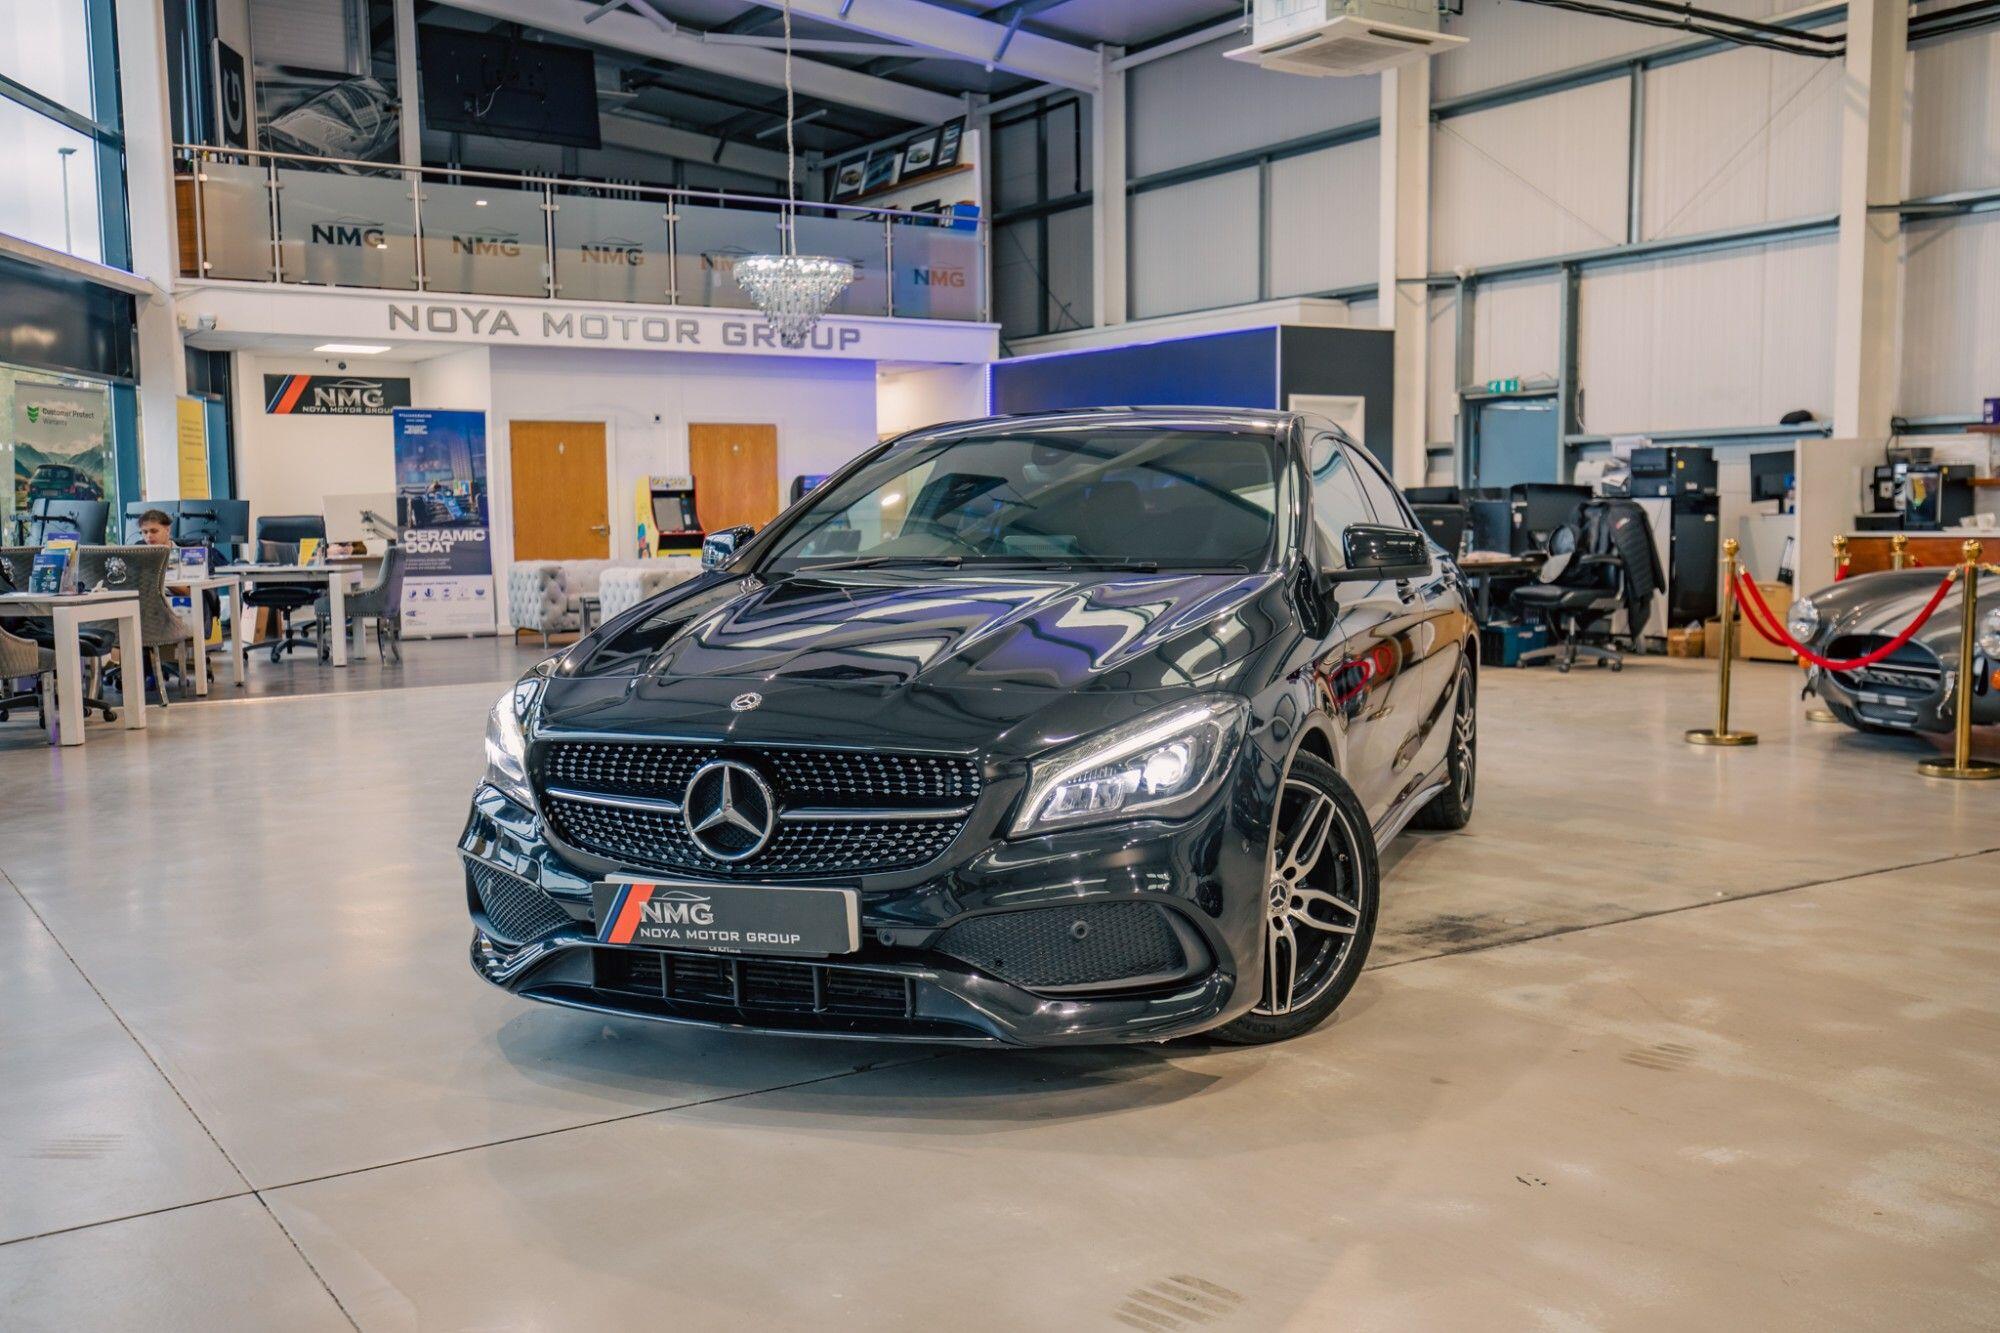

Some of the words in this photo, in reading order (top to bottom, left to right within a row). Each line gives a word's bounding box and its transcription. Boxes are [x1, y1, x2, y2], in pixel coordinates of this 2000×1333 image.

[311, 223, 385, 248] NMG
[452, 235, 520, 257] NMG
[580, 244, 644, 266] NMG
[700, 253, 738, 271] NM
[914, 268, 965, 287] NMG
[388, 303, 520, 336] NOYA
[542, 312, 701, 345] MOTOR
[314, 387, 384, 407] NMG
[42, 408, 71, 417] Customer
[72, 410, 95, 419] Protect
[330, 406, 362, 414] MOTOR
[403, 529, 486, 542] CERAMIC
[405, 541, 455, 554] COAT
[639, 901, 714, 925] NMG
[640, 928, 680, 939] NOYA
[686, 931, 740, 942] MOTOR
[746, 932, 801, 944] GROUP
